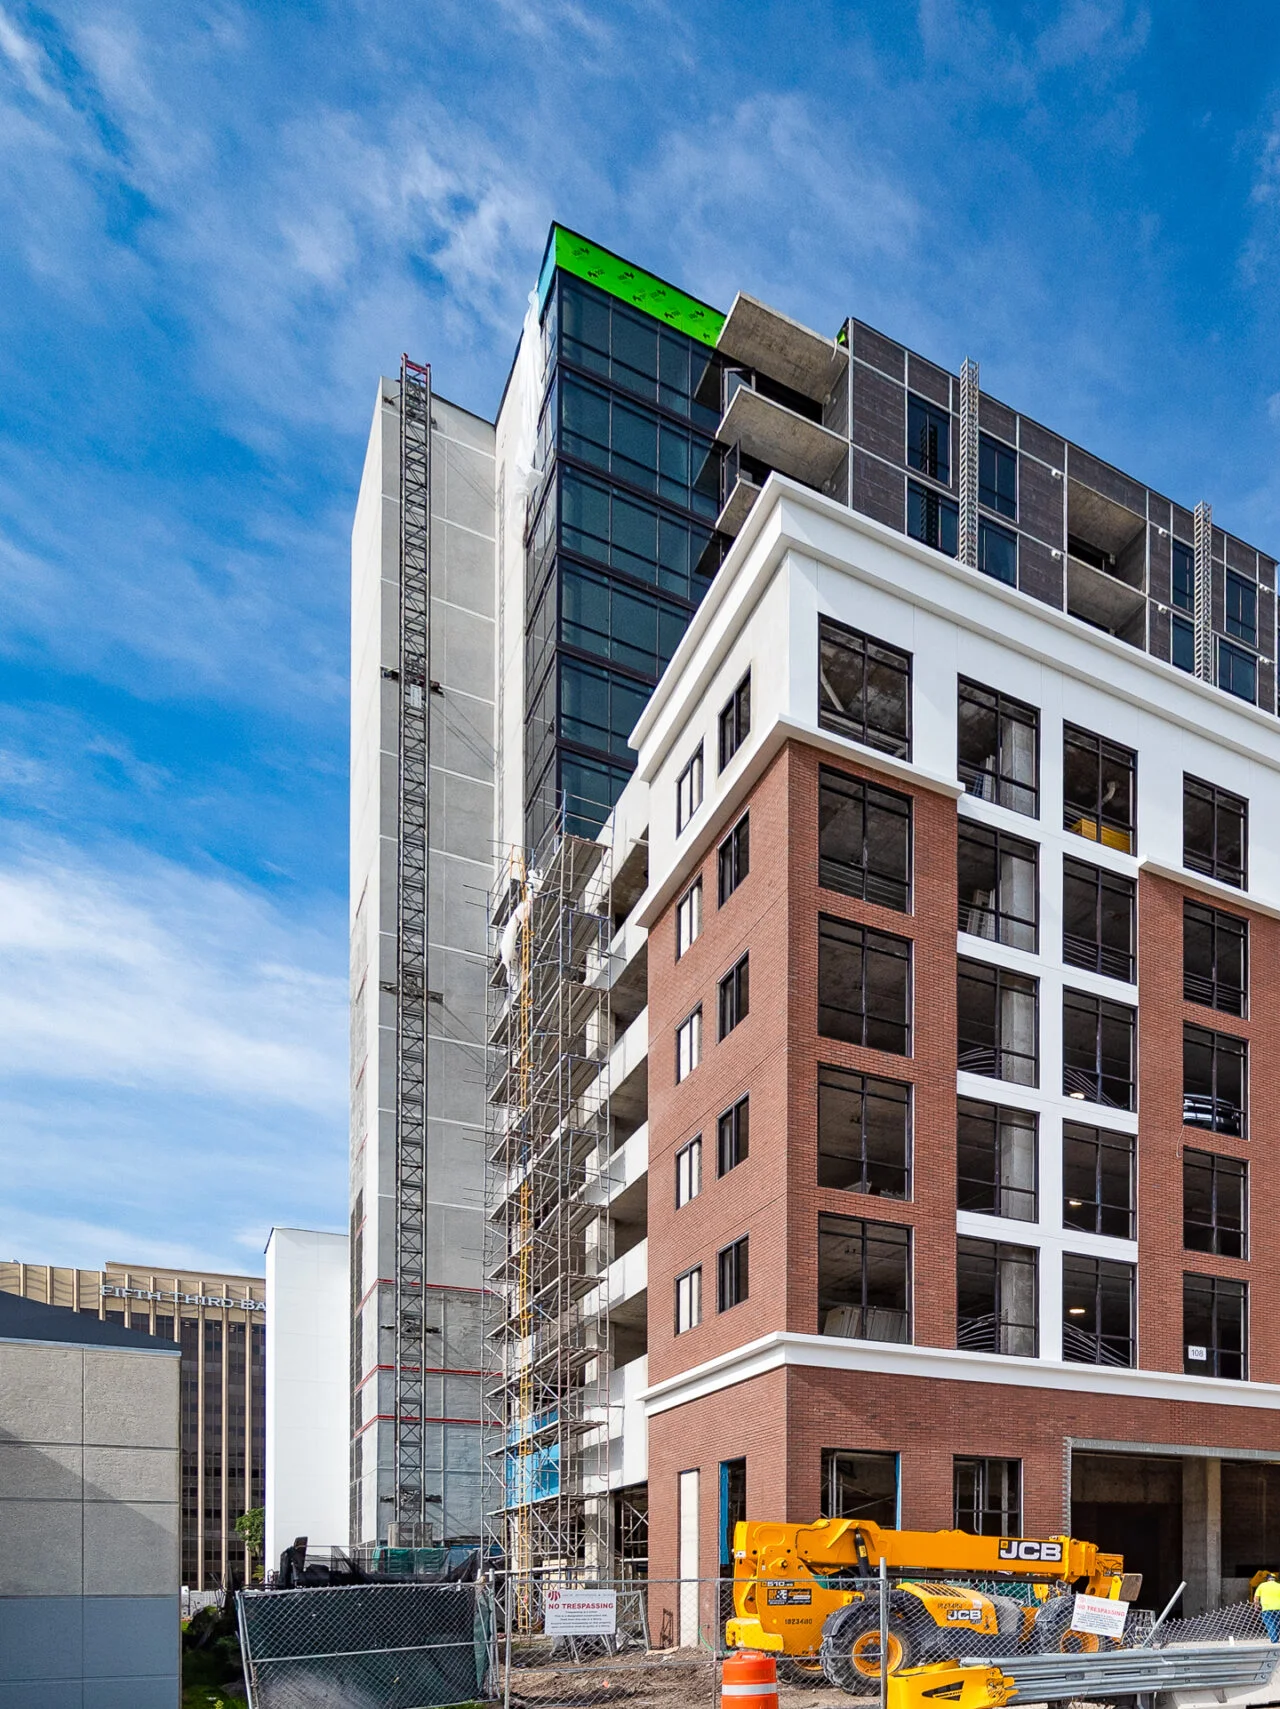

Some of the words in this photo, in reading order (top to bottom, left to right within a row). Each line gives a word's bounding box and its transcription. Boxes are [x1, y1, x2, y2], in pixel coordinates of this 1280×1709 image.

[100, 1284, 162, 1301] FIFTH
[168, 1291, 234, 1308] THIRD
[1191, 1349, 1204, 1358] 108
[1000, 1541, 1062, 1561] JCB
[948, 1610, 981, 1620] JCB
[1087, 1606, 1125, 1617] TRESPASSING
